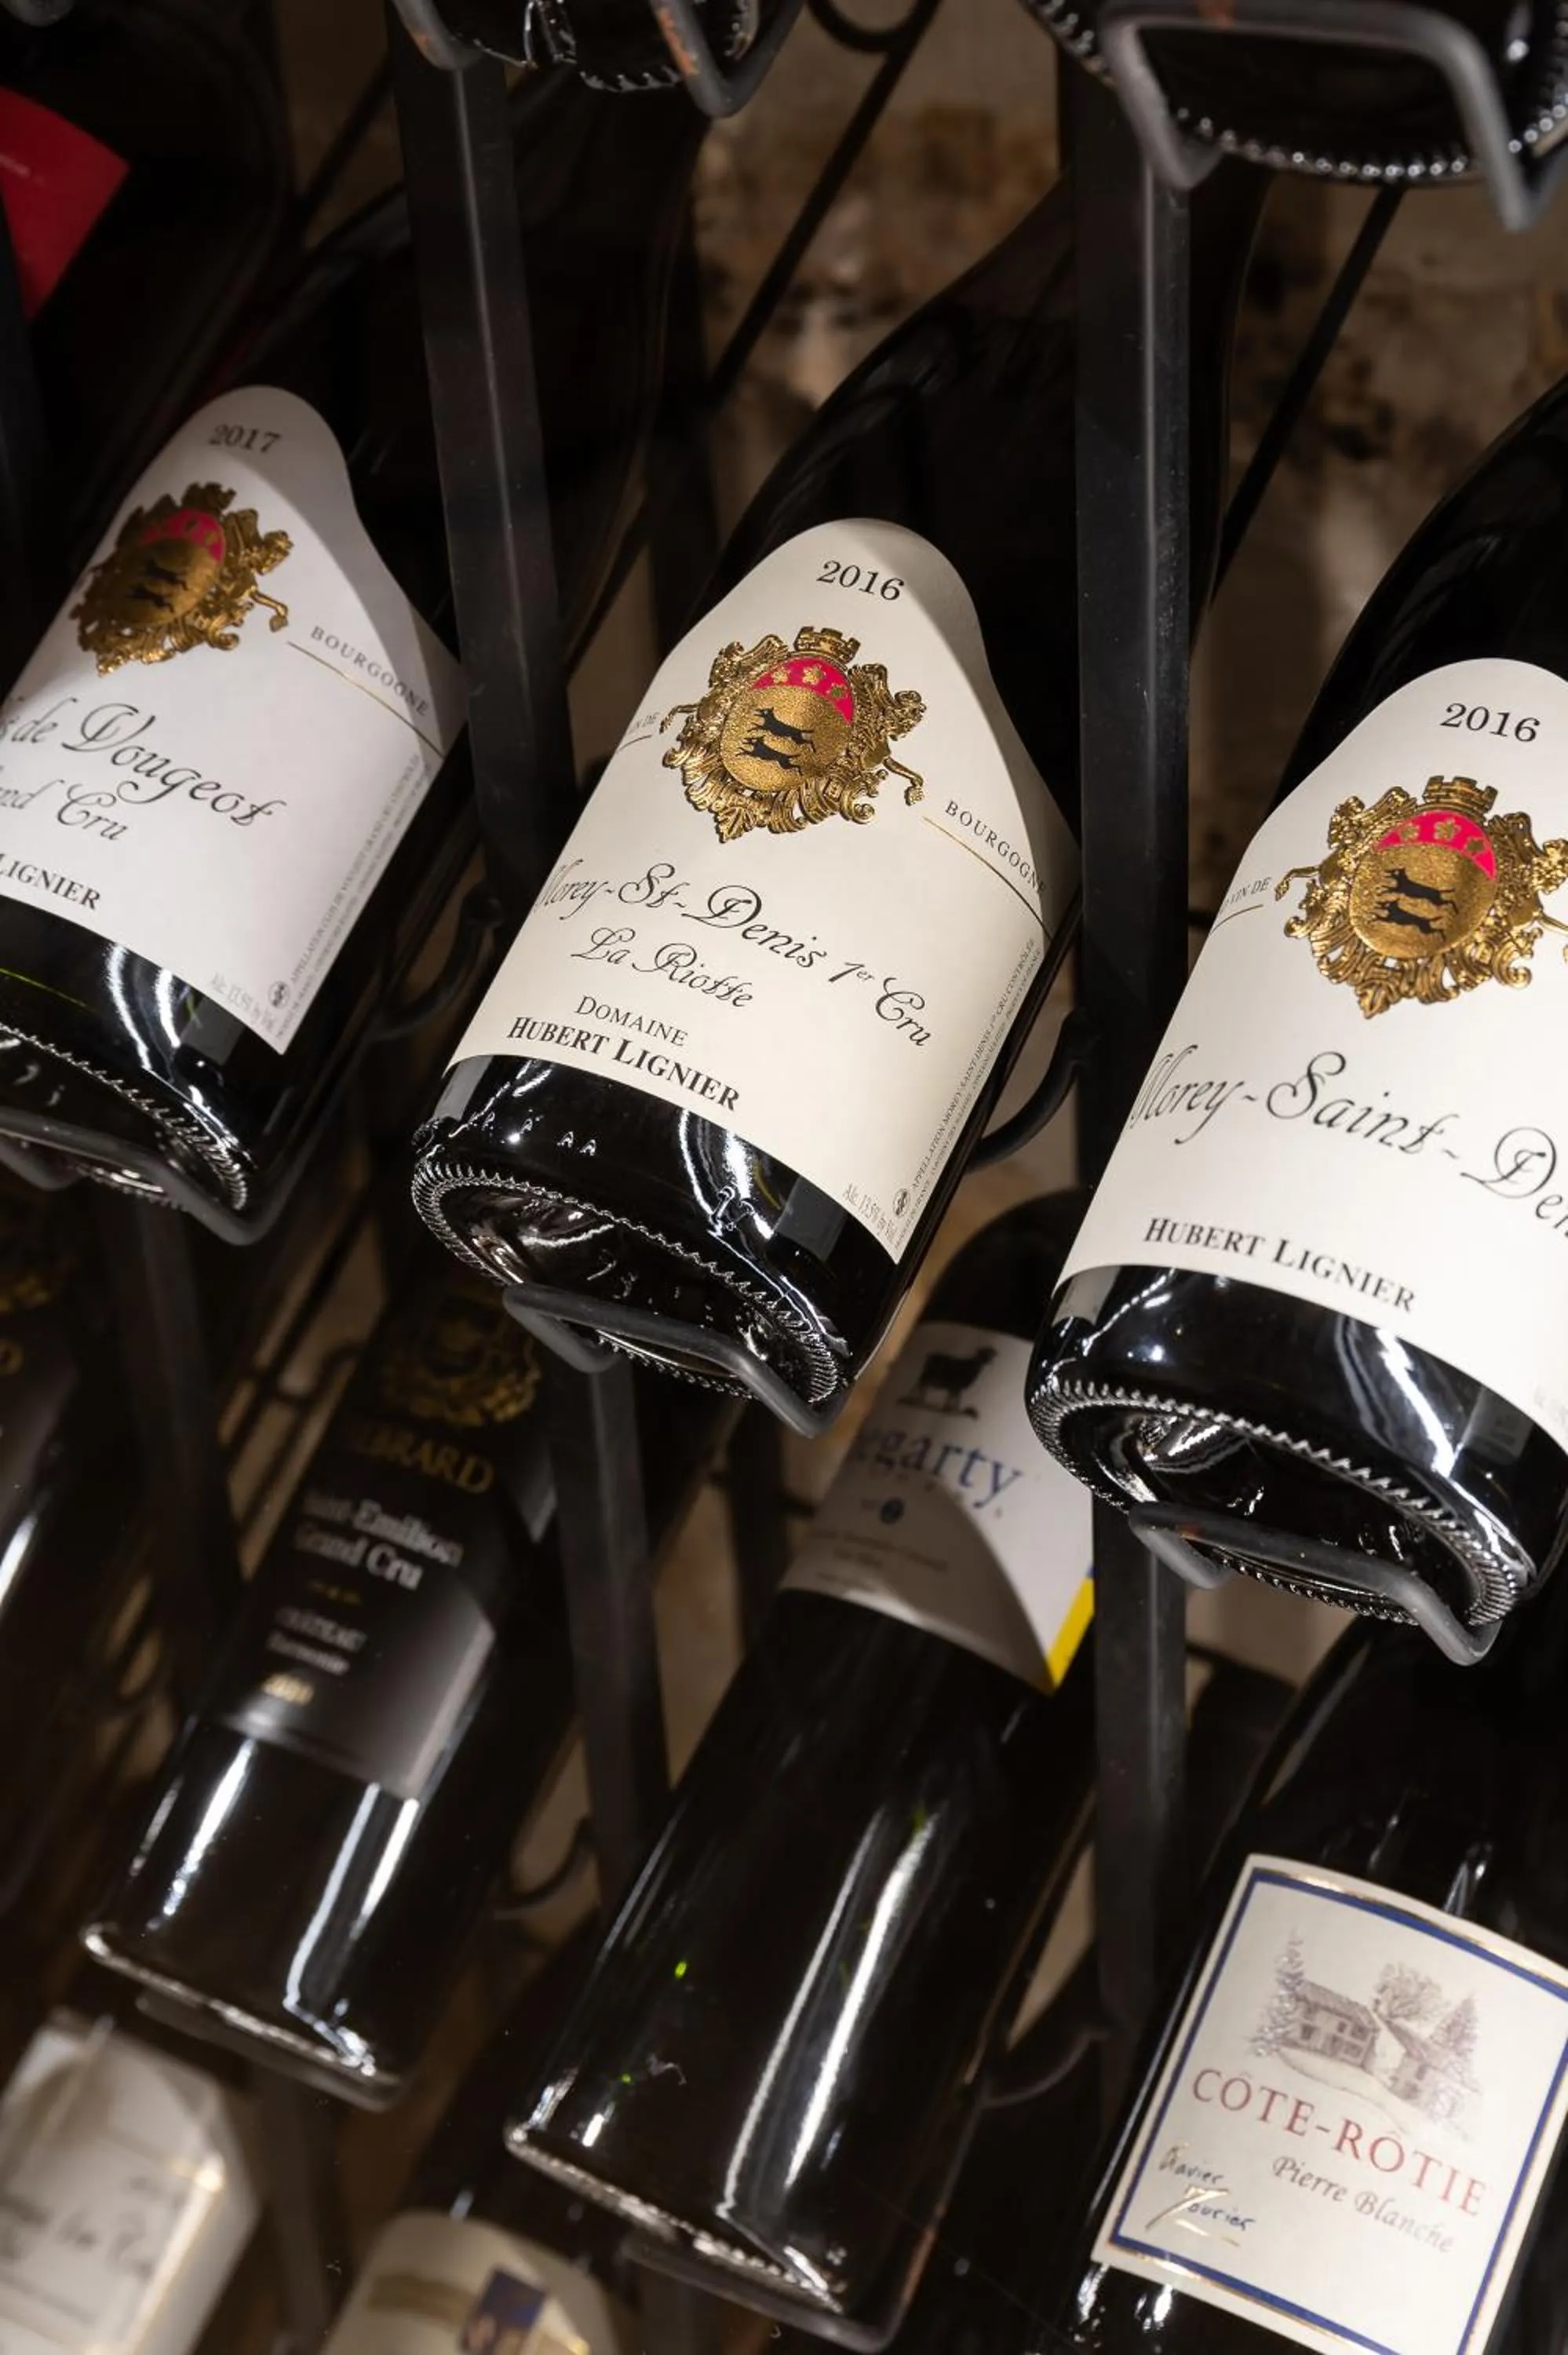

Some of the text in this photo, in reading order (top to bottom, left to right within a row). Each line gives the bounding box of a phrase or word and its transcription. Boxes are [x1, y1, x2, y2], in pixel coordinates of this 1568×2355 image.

[210, 424, 281, 453] 2017
[816, 560, 905, 601] 2016
[1440, 703, 1541, 743] 2016
[61, 703, 286, 825] Vougeot
[57, 783, 128, 840] Cru
[571, 927, 753, 1007] La Riotte
[575, 995, 688, 1047] DOMAINE
[875, 977, 932, 1046] Cru
[507, 1017, 740, 1111] HUBERT LIGNIER
[1143, 1218, 1418, 1314] HUBERT LIGNIER
[1191, 2068, 1488, 2215] CÔTE-RÔTIE
[1272, 2155, 1456, 2254] Pierre Blanche
